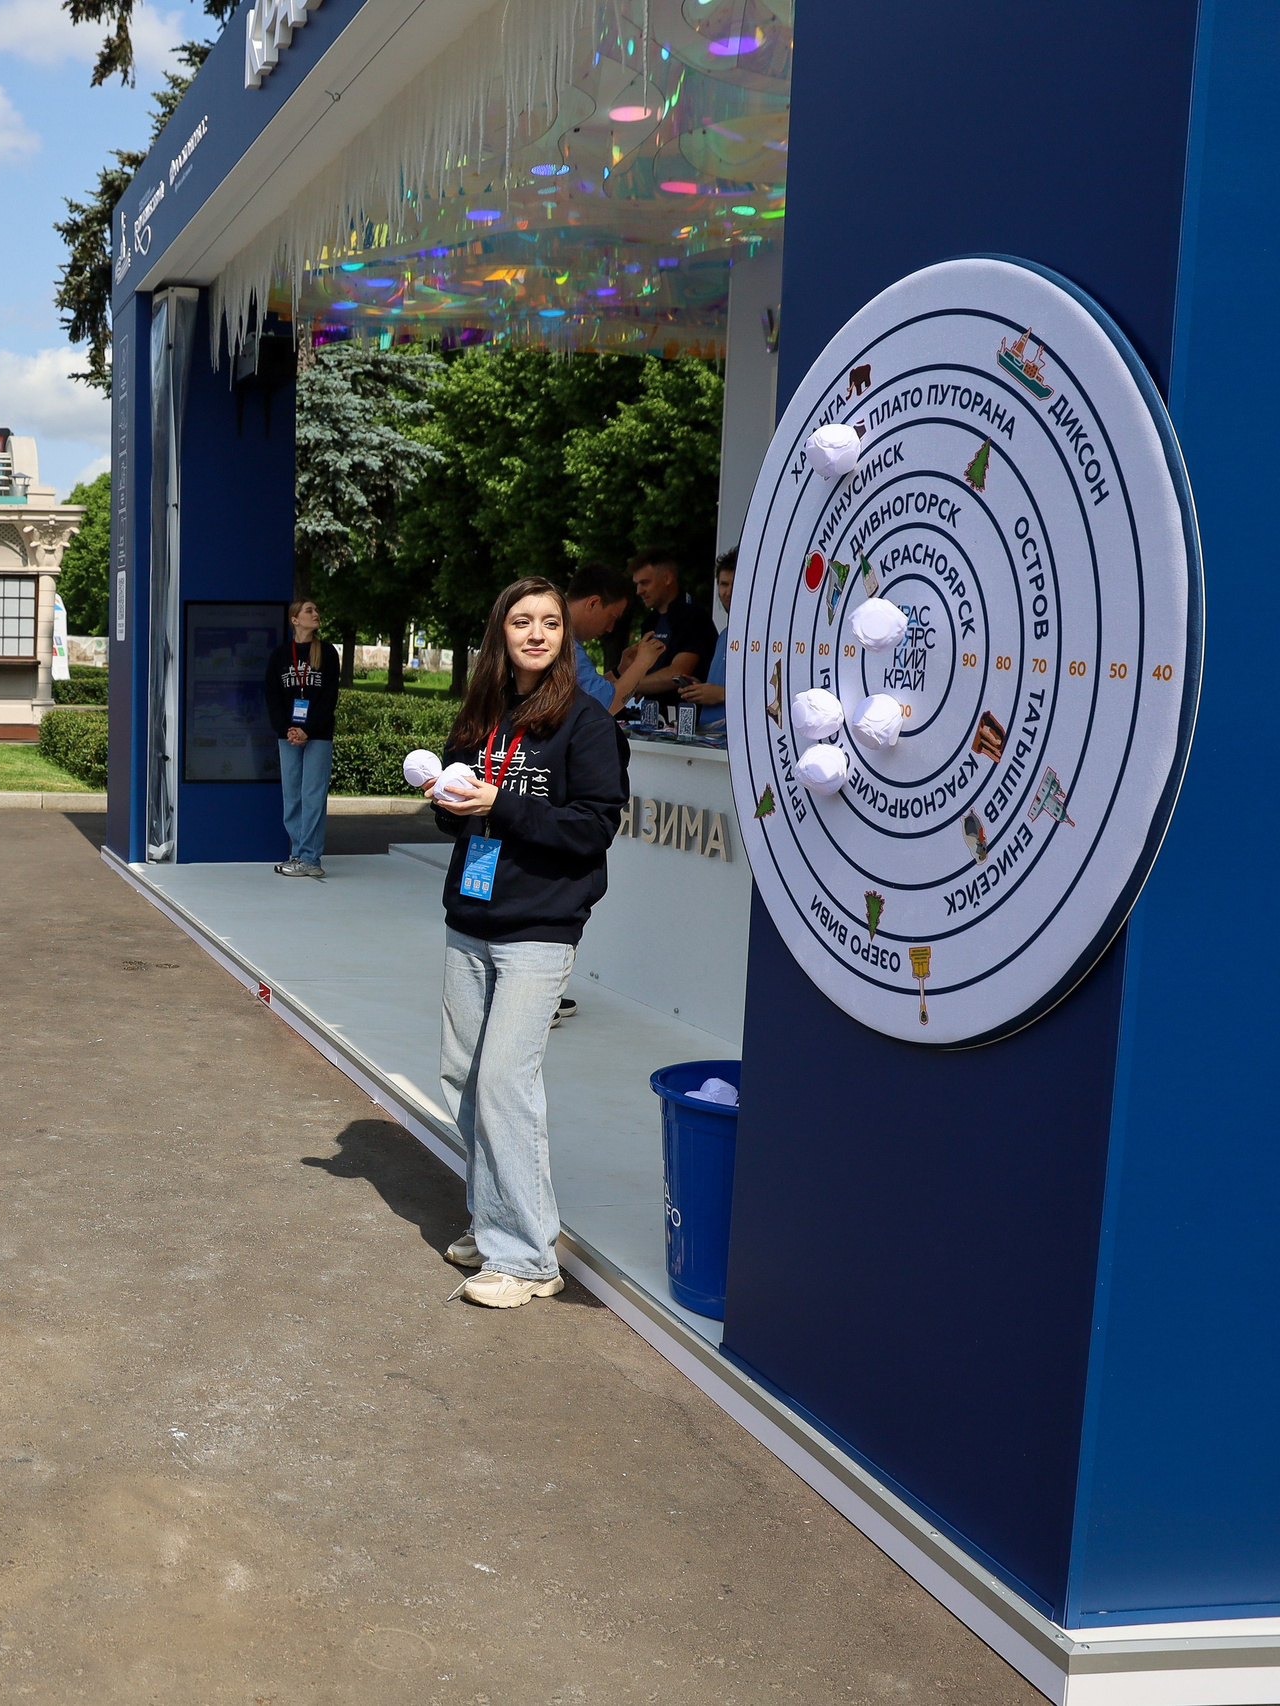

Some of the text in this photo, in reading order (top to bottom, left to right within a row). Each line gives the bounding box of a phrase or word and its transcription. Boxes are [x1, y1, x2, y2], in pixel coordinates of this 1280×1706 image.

[869, 384, 1015, 441] ПЛАТО ПУТОРАНА
[1047, 393, 1110, 507] ДИКСОН
[818, 441, 905, 552] МИНУСИНСК
[849, 491, 962, 562] ДИВНОГОРСК
[879, 543, 976, 640] КРАСНОЯРСК
[729, 640, 740, 652] 40
[750, 640, 761, 653] 50
[772, 641, 783, 653] 60
[795, 642, 806, 654] 70
[818, 643, 830, 656] 80
[844, 644, 856, 658] 90
[892, 648, 927, 671] КИЙ
[962, 653, 977, 668] 90
[984, 516, 1049, 824] ОСТРОВ ТАТЫШЕВ
[995, 655, 1012, 671] 80
[1031, 658, 1047, 674] 70
[1069, 660, 1087, 677] 60
[1109, 662, 1128, 680] 50
[883, 667, 925, 692] КРАЙ
[1152, 664, 1173, 681] 40
[776, 734, 807, 824] ЕРГАКИ
[848, 752, 979, 819] КРАСНОЯРСКИЕ
[641, 798, 733, 863] ЗИМА
[943, 821, 1034, 917] ЕНИСЕЙСК
[810, 894, 901, 973] ОЗЕРО ВИВИ
